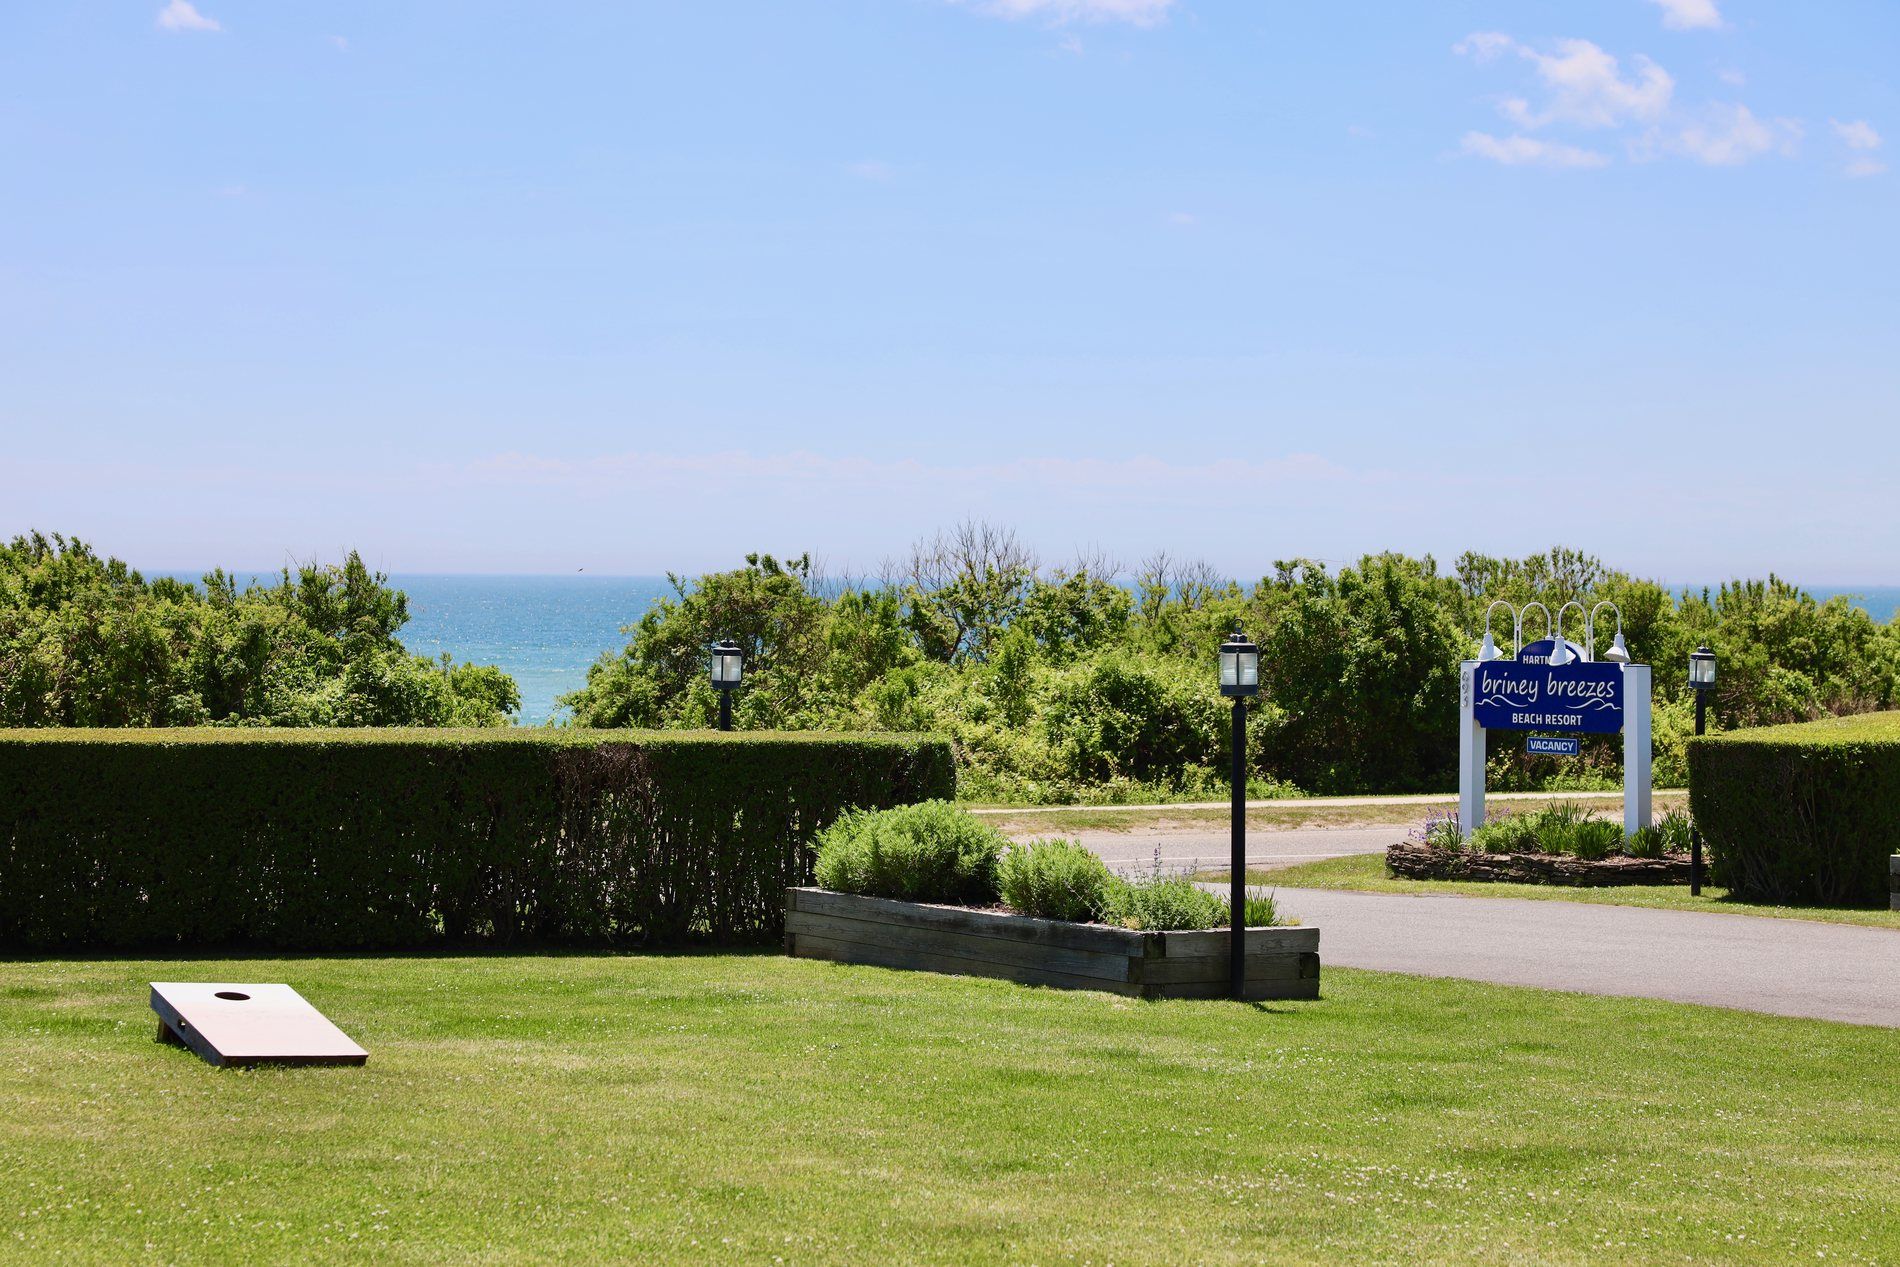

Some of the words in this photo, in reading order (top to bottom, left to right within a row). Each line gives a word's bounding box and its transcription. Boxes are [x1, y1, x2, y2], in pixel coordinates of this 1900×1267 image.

[1482, 670, 1539, 702] briney
[1547, 672, 1616, 698] breezes
[1512, 713, 1542, 725] BEACH
[1545, 714, 1583, 726] RESORT
[1530, 740, 1574, 752] VACANCY
